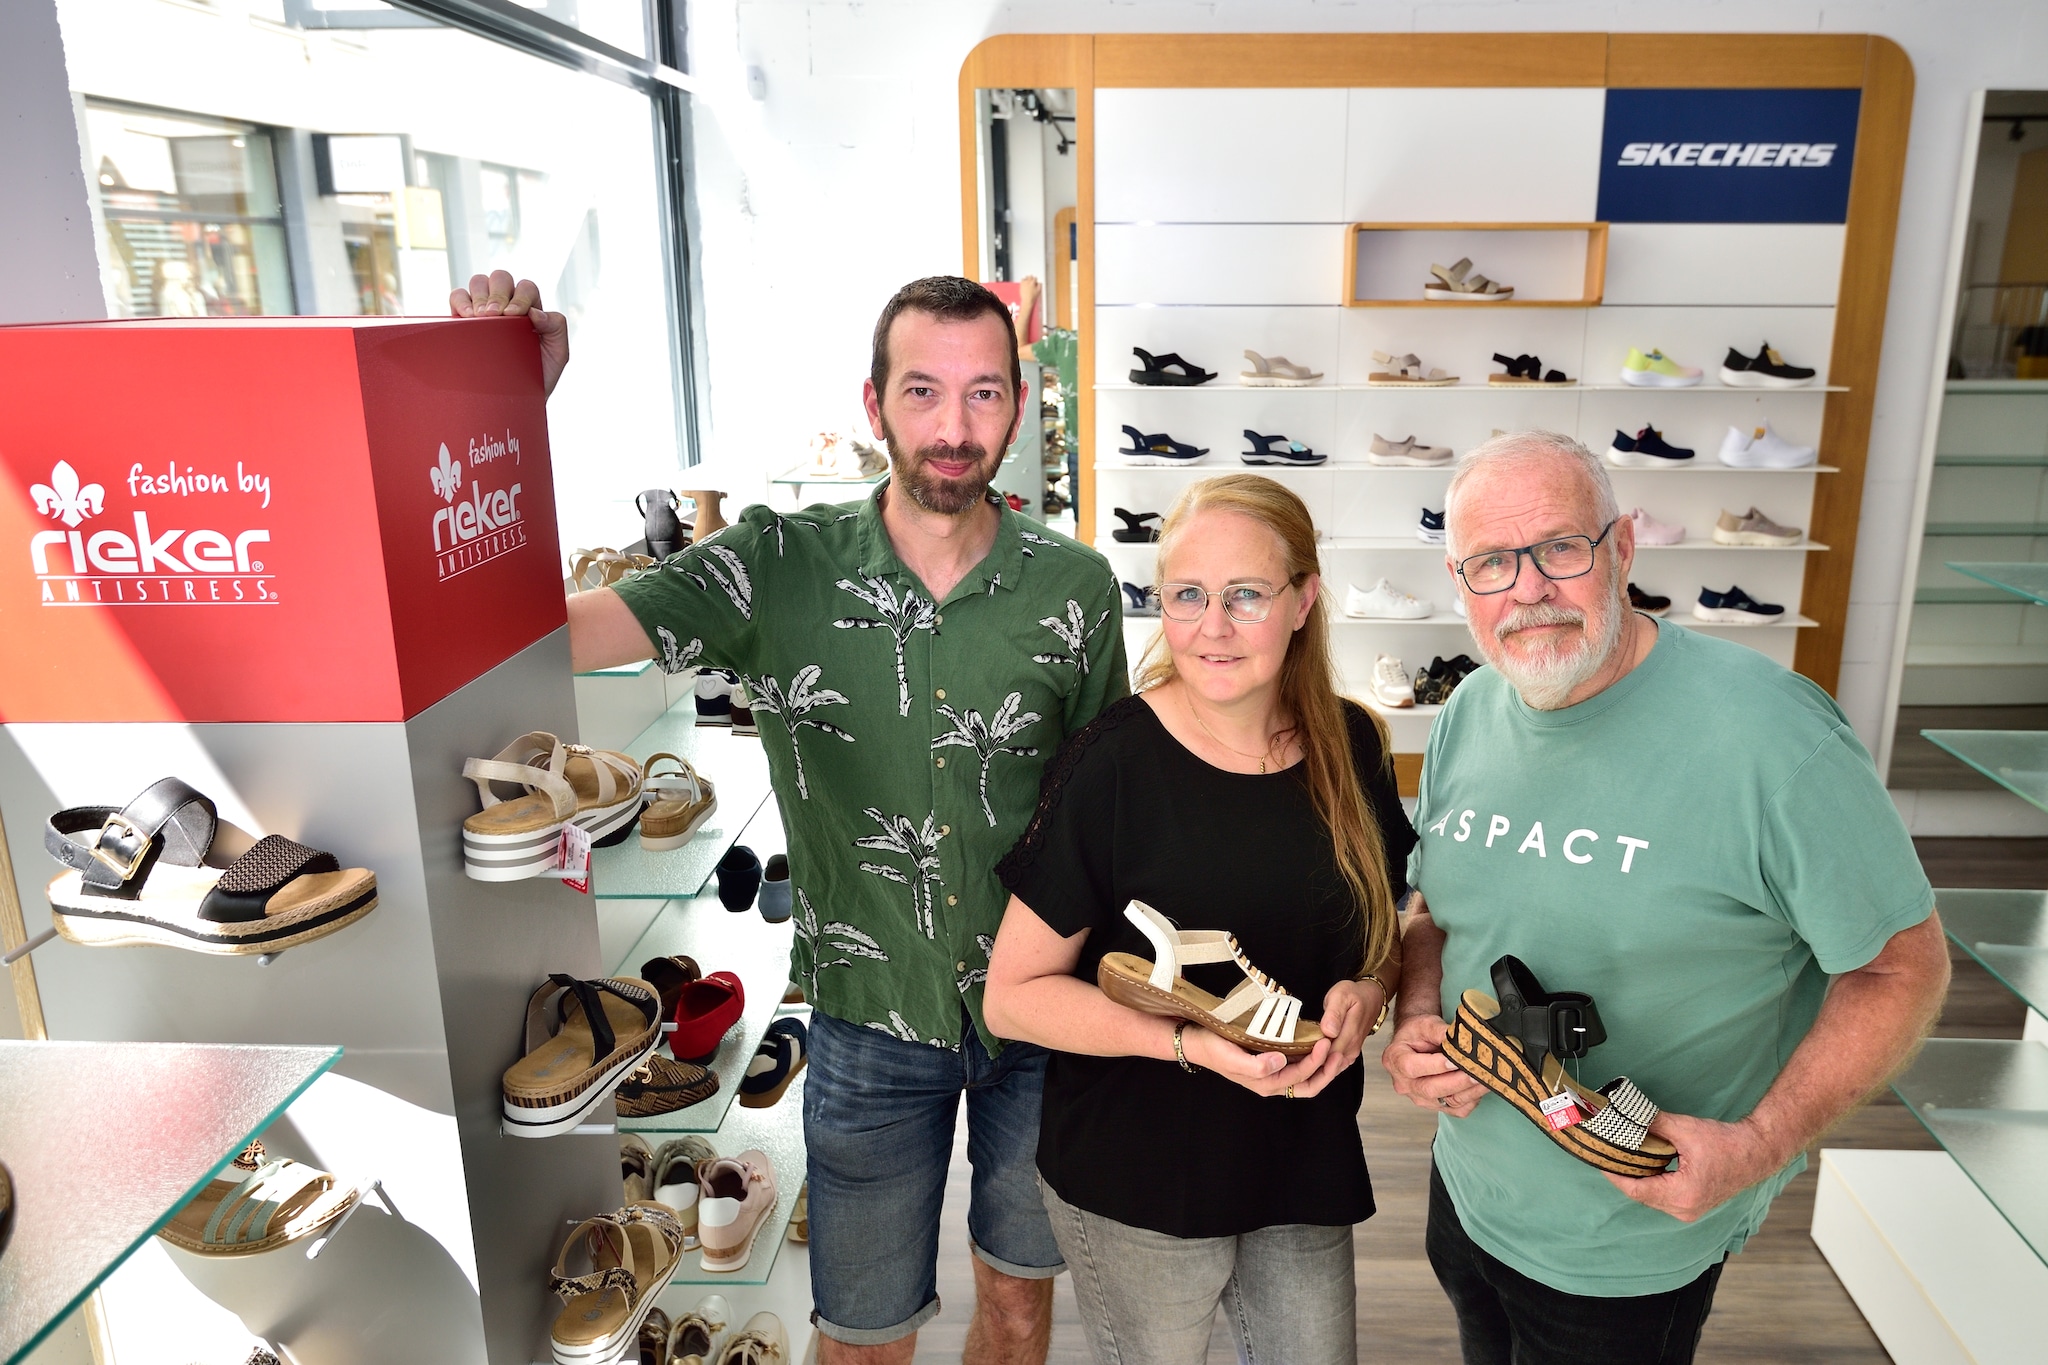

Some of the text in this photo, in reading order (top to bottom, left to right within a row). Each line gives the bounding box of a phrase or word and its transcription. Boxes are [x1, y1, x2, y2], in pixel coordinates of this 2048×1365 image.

[1617, 142, 1838, 168] SKECHERS
[468, 427, 521, 468] fashion by
[127, 460, 271, 509] fashion by
[432, 479, 522, 552] rieker
[30, 510, 271, 575] rieker
[438, 525, 524, 578] ANTISTRESS
[42, 579, 269, 602] ANTISTRESS
[1429, 808, 1650, 874] ASPACT
